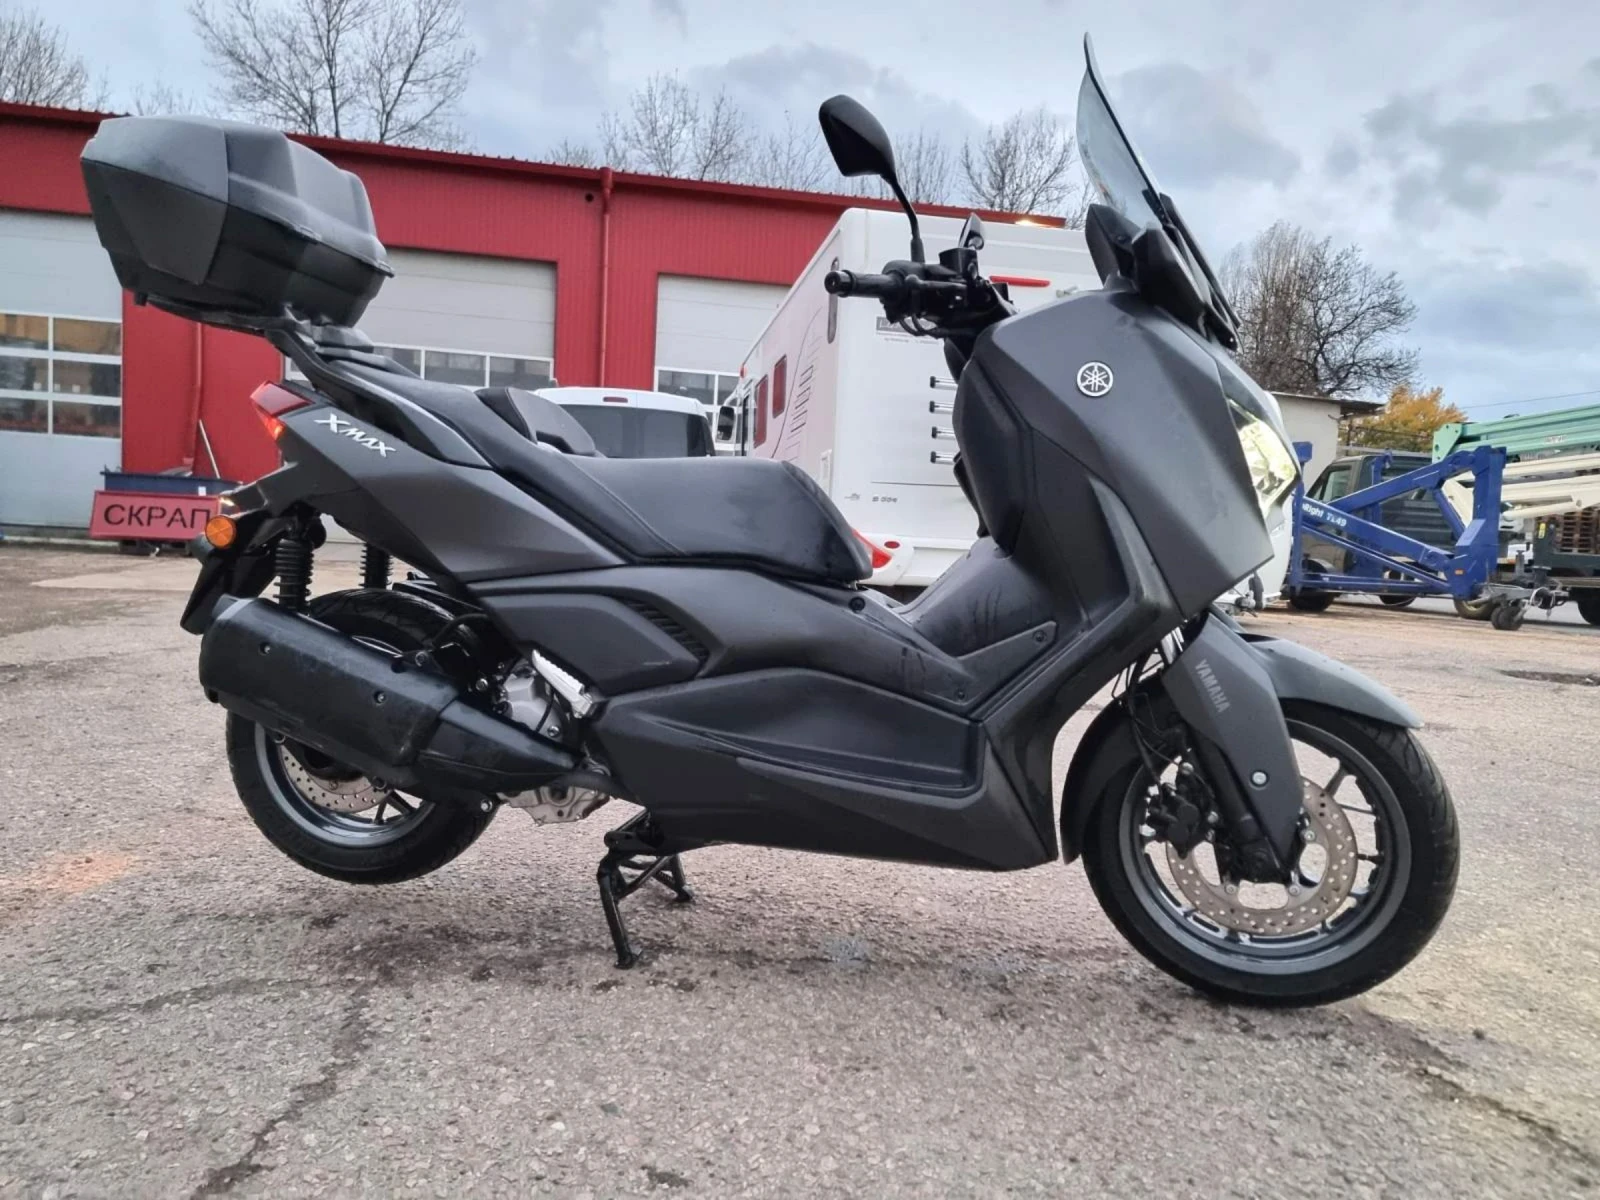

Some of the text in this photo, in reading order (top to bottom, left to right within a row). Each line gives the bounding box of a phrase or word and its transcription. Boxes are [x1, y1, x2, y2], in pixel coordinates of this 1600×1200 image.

[313, 413, 397, 458] XMAX
[104, 503, 210, 529] СКРАП
[1195, 658, 1231, 713] YAMAHA
